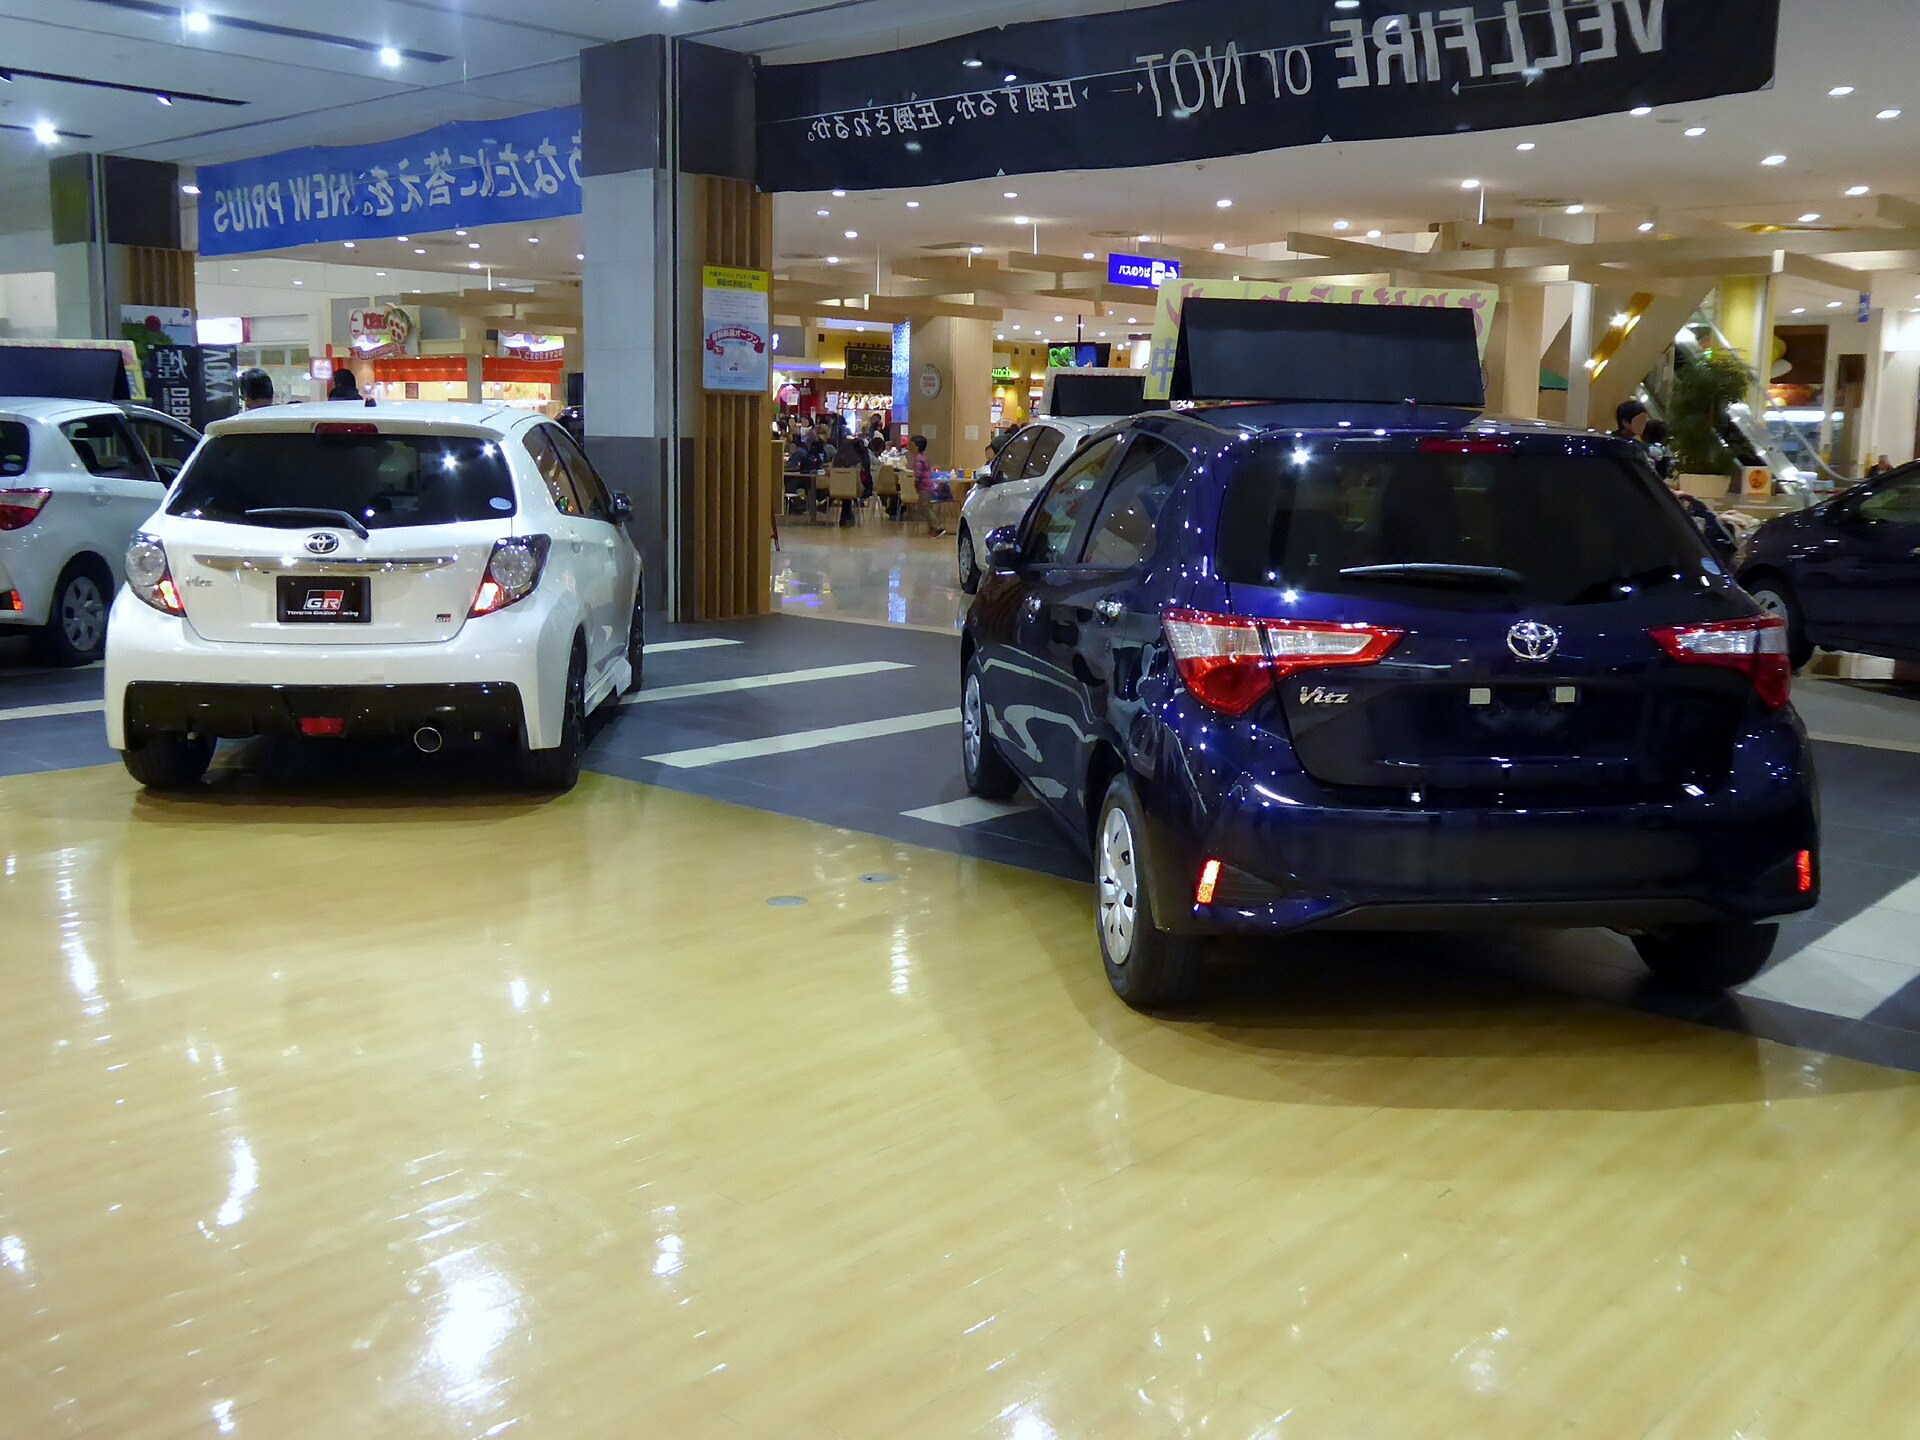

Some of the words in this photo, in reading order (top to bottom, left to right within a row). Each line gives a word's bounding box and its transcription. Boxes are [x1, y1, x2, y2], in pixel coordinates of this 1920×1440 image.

[1118, 264, 1151, 278] バスのりば
[306, 597, 340, 608] GR
[1299, 686, 1349, 705] Vitz
